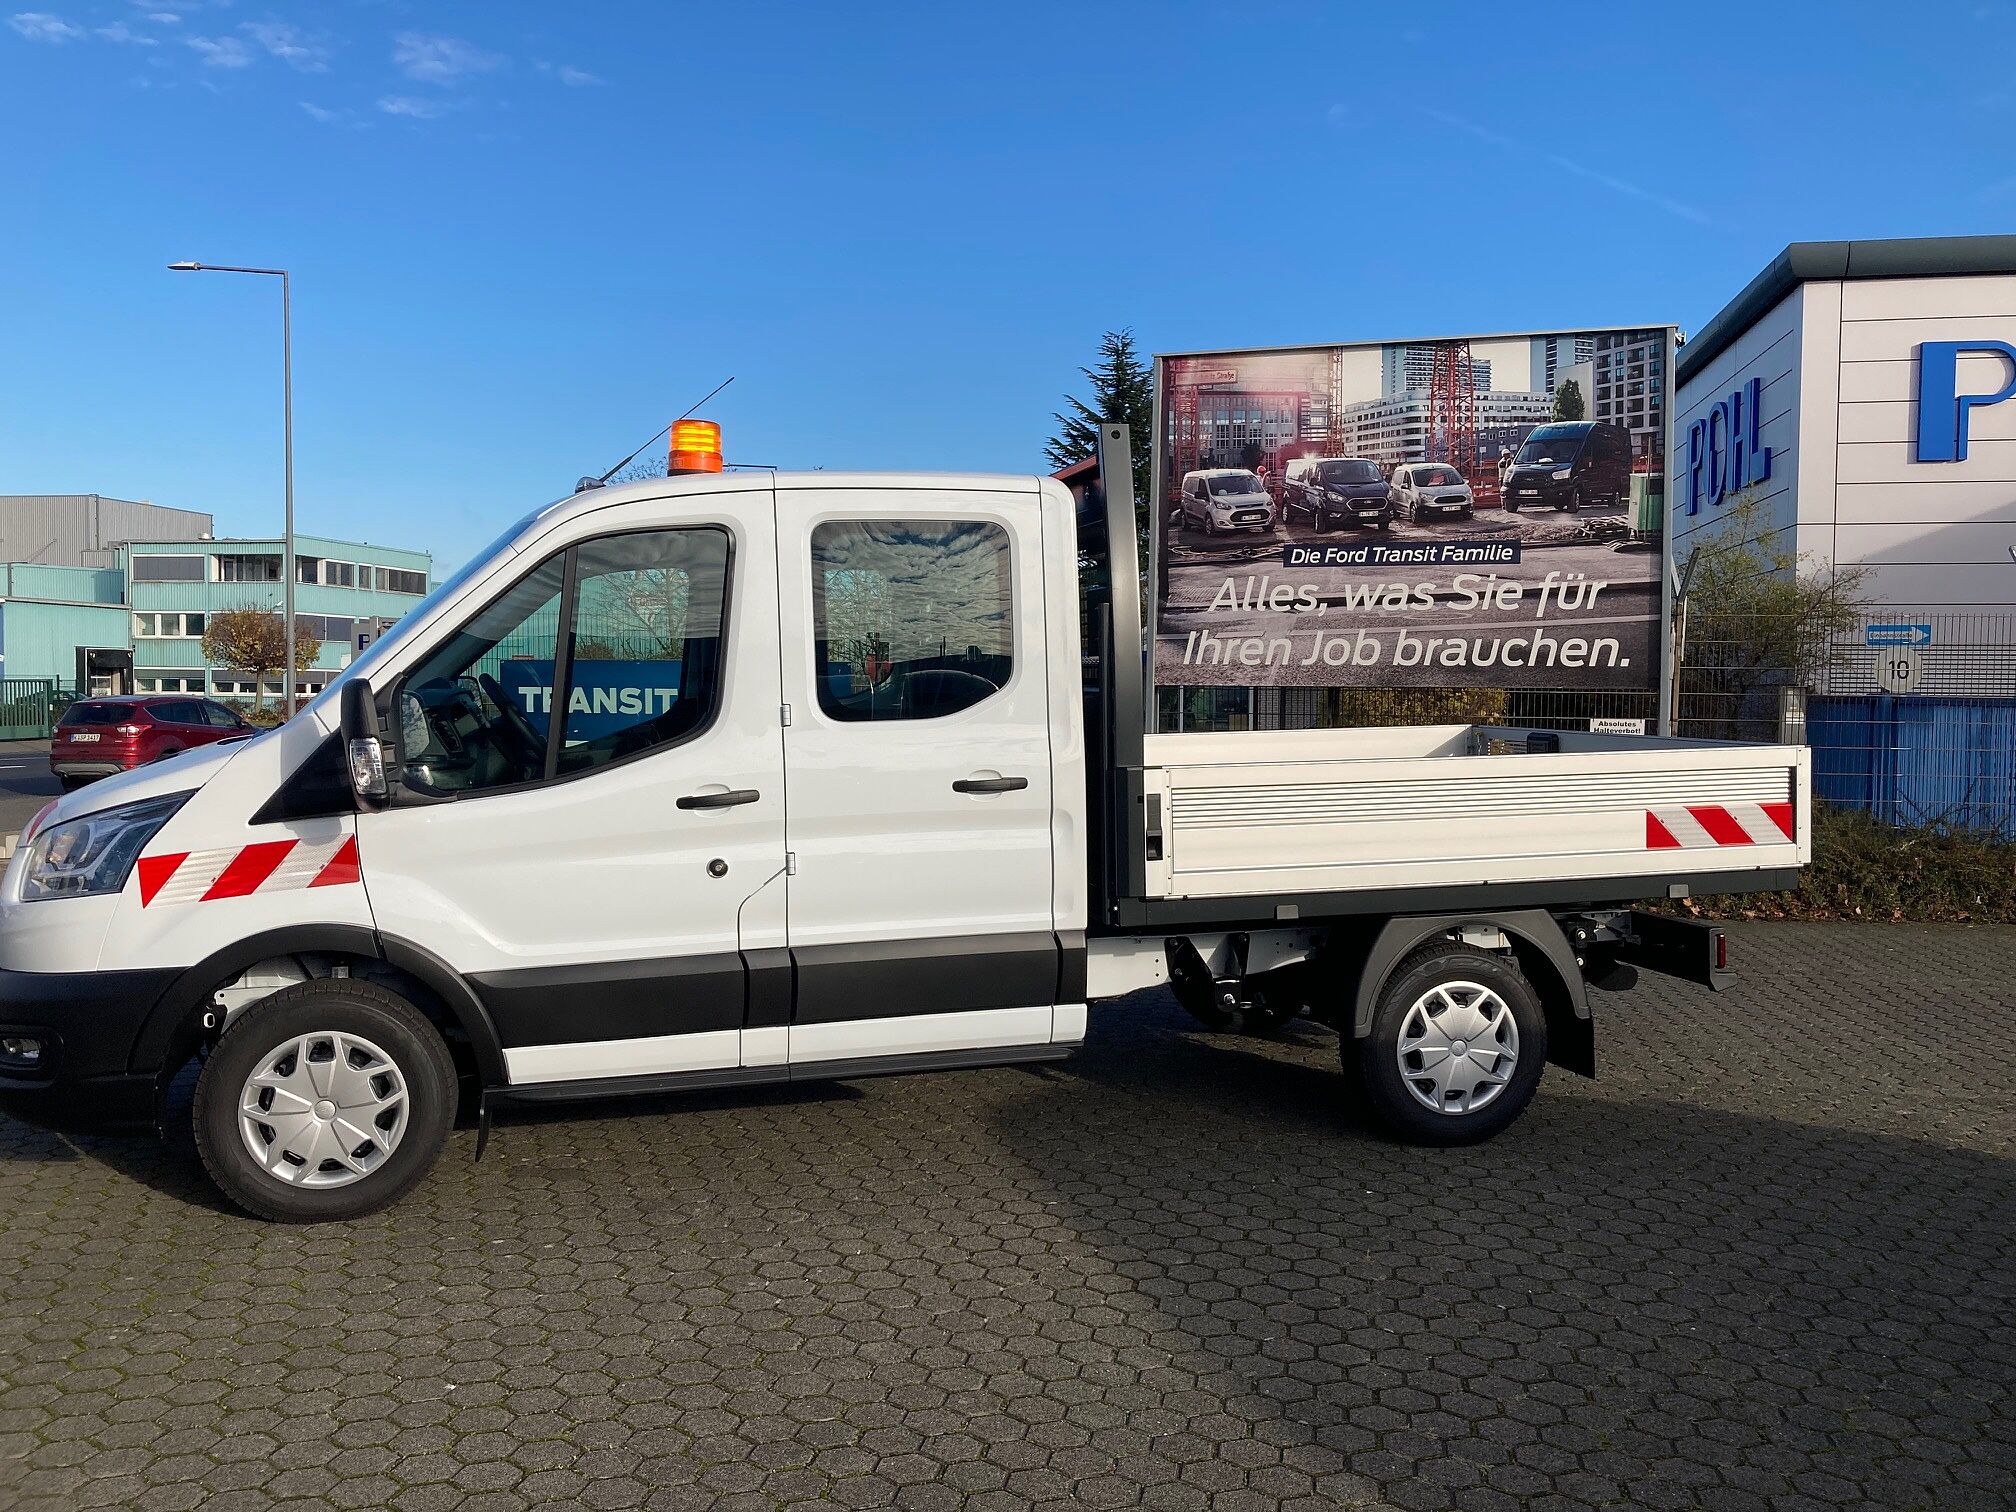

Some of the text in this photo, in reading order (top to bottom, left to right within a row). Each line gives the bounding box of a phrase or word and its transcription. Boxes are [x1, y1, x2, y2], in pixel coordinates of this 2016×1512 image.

[1685, 377, 1771, 516] POHL
[1290, 544, 1514, 564] Die Ford Transit Familie
[1207, 571, 1608, 618] Alles, was Sie für
[1182, 628, 1631, 668] Ihren Job brauchen.
[1888, 660, 1910, 680] 10
